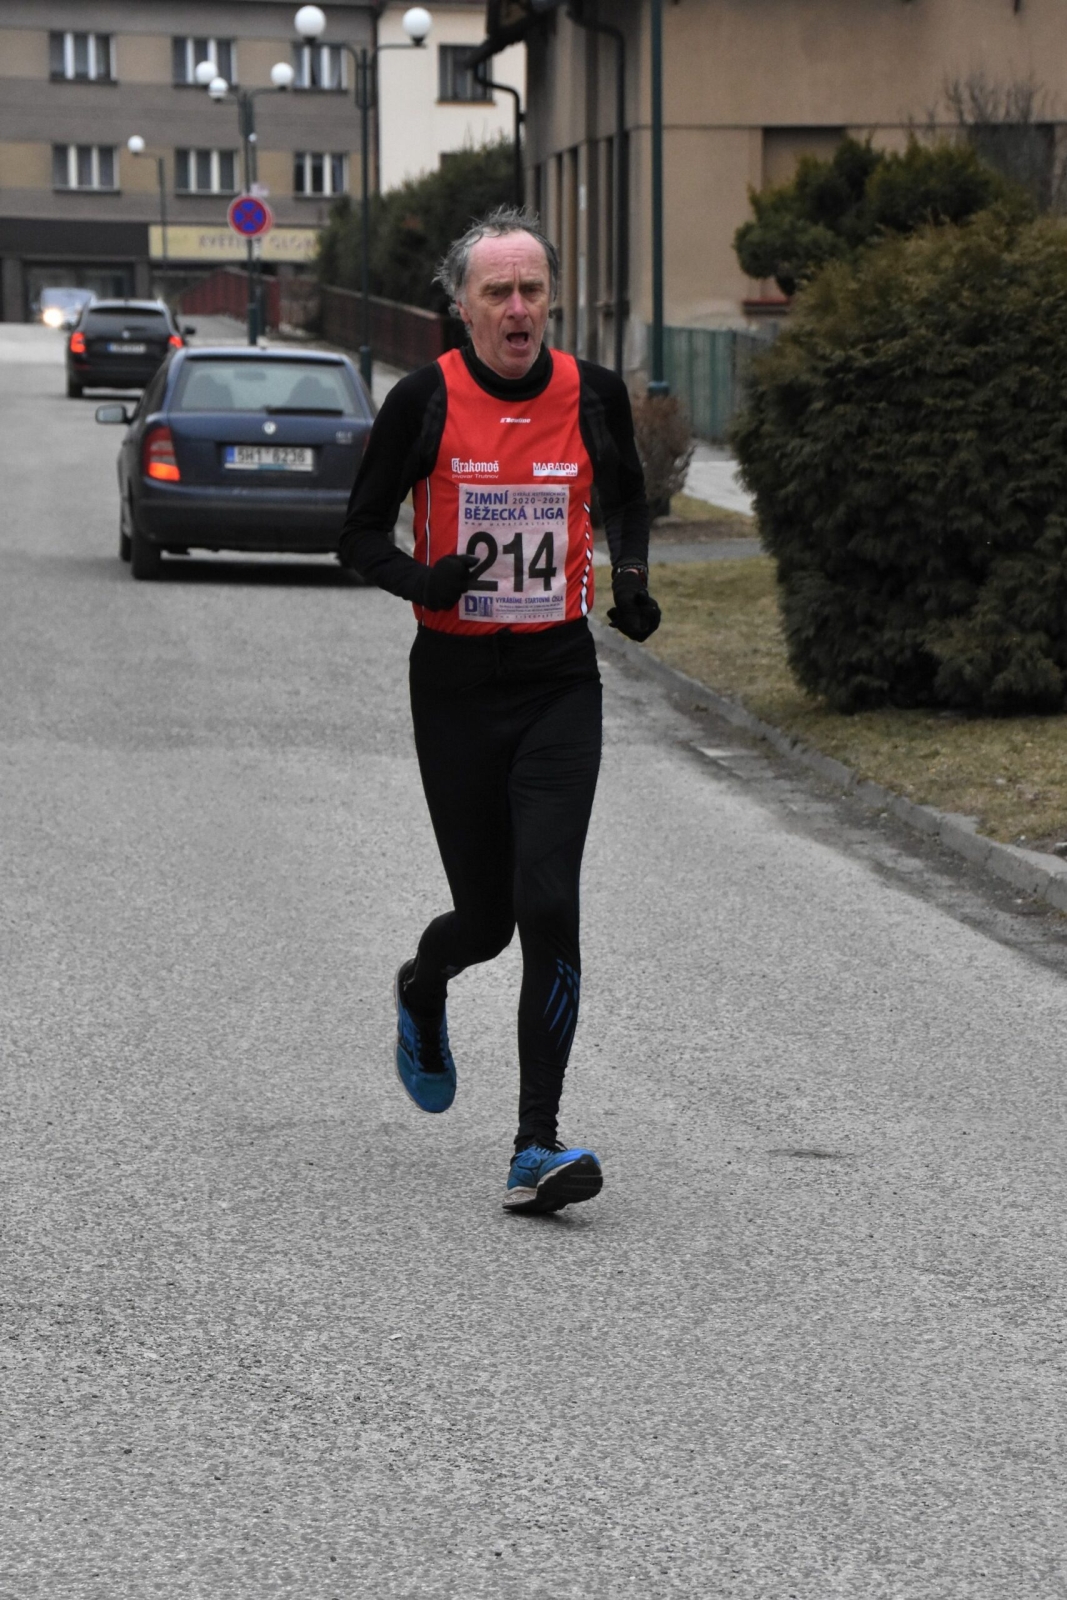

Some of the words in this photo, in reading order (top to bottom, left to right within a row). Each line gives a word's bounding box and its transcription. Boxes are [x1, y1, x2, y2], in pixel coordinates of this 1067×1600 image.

[451, 457, 499, 474] Krakonoš
[533, 462, 578, 471] MARATON
[465, 490, 509, 505] ZIMNÍ
[464, 505, 527, 521] BĚŽECKÁ
[533, 507, 565, 520] LIGA
[466, 531, 557, 593] 214
